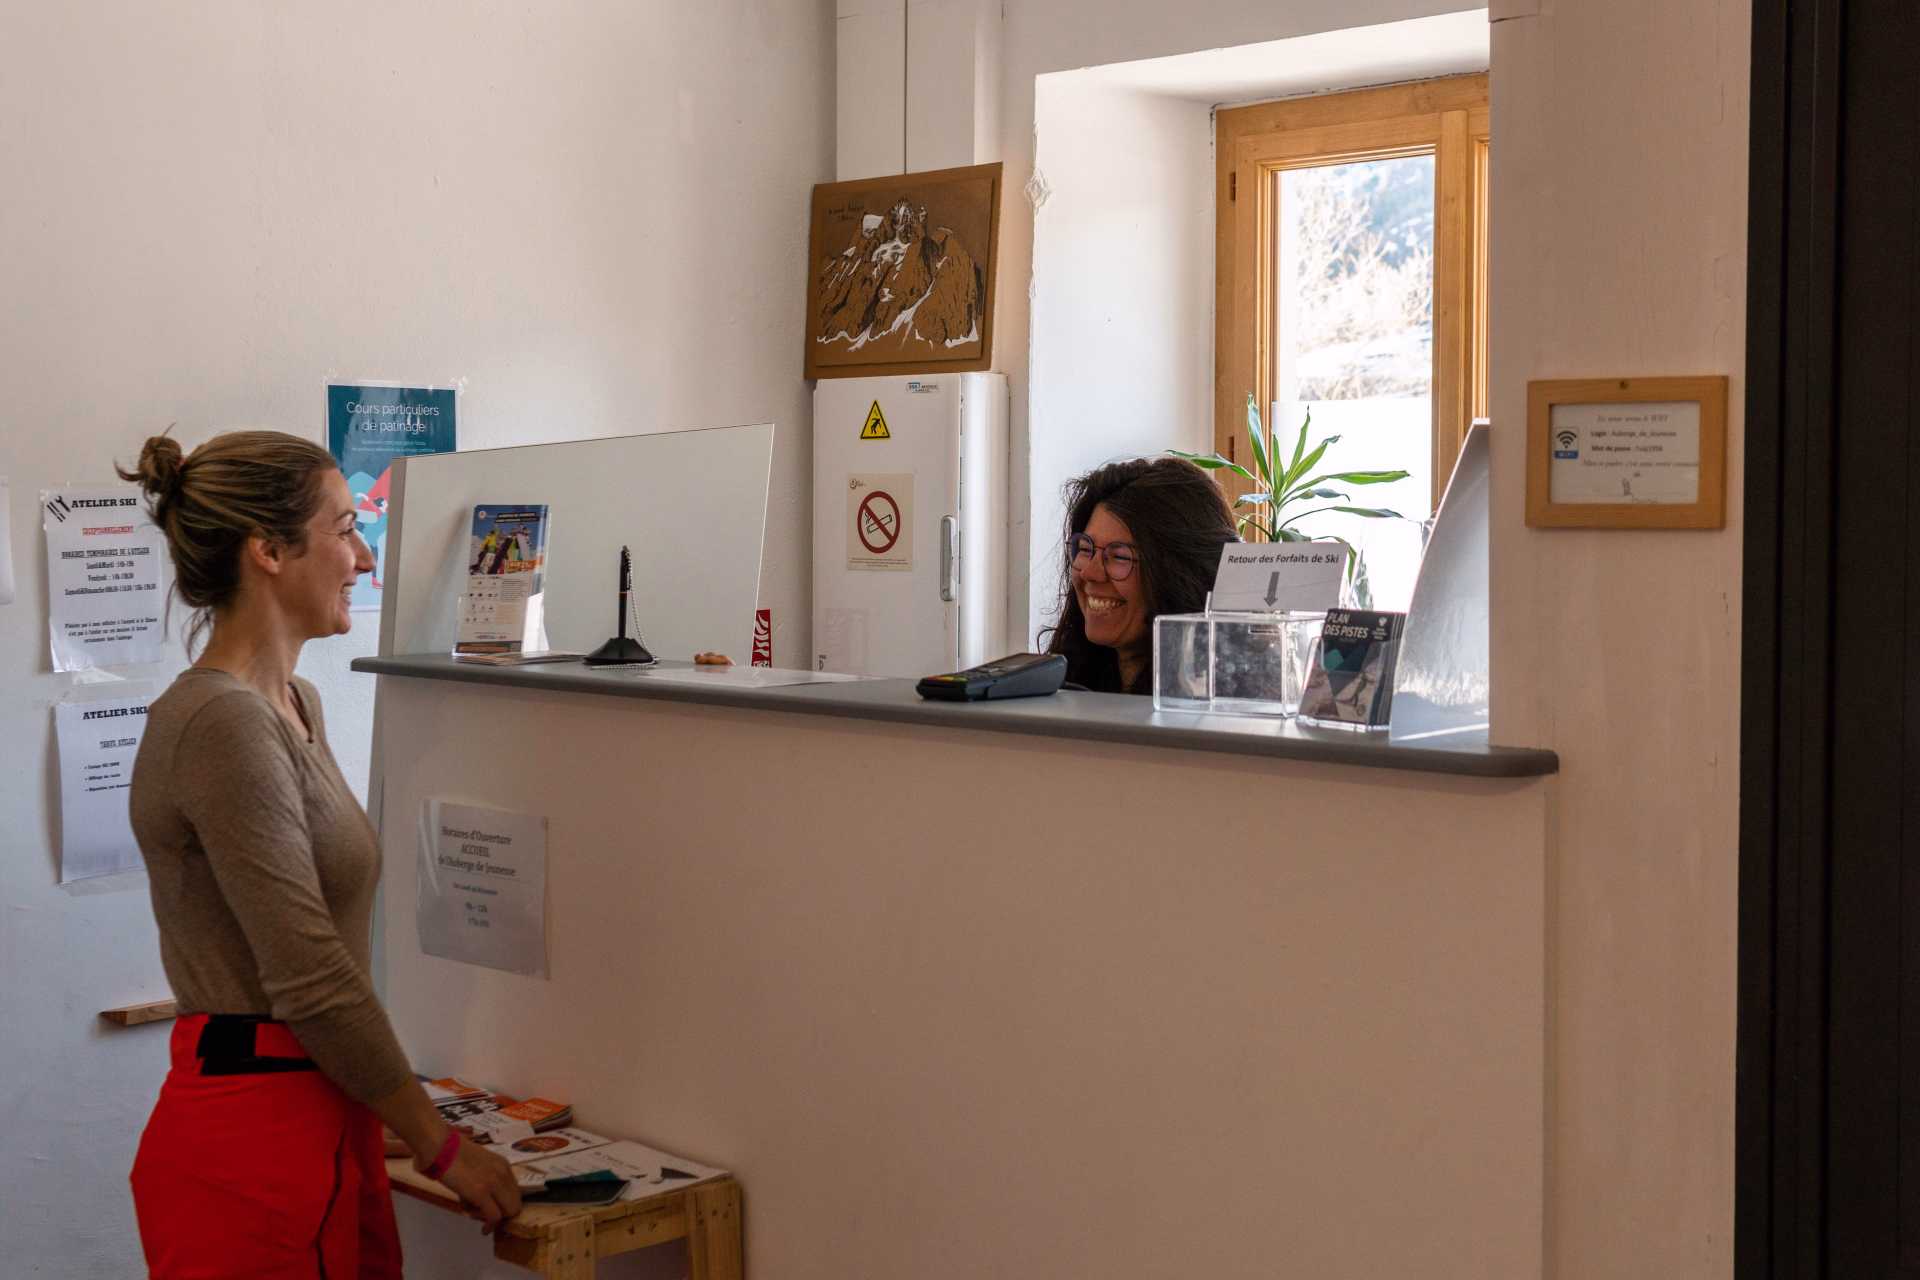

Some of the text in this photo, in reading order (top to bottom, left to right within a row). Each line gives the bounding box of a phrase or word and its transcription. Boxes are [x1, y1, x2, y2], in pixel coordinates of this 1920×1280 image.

[346, 402, 439, 416] Cours particuliers
[362, 420, 425, 434] de patinage
[71, 498, 137, 508] ATELIER SKI
[86, 549, 118, 557] TEMPORAIRES
[1228, 554, 1339, 564] Retour des Forfaits de Ski
[1327, 612, 1350, 624] PLAN
[1324, 624, 1369, 638] DES PISTES
[83, 706, 148, 720] ATELIER SKI
[442, 826, 512, 845] Horaires d'Ouverture
[461, 844, 490, 857] ACCUEIL
[438, 854, 516, 876] de l'Auberge de Jeunesse
